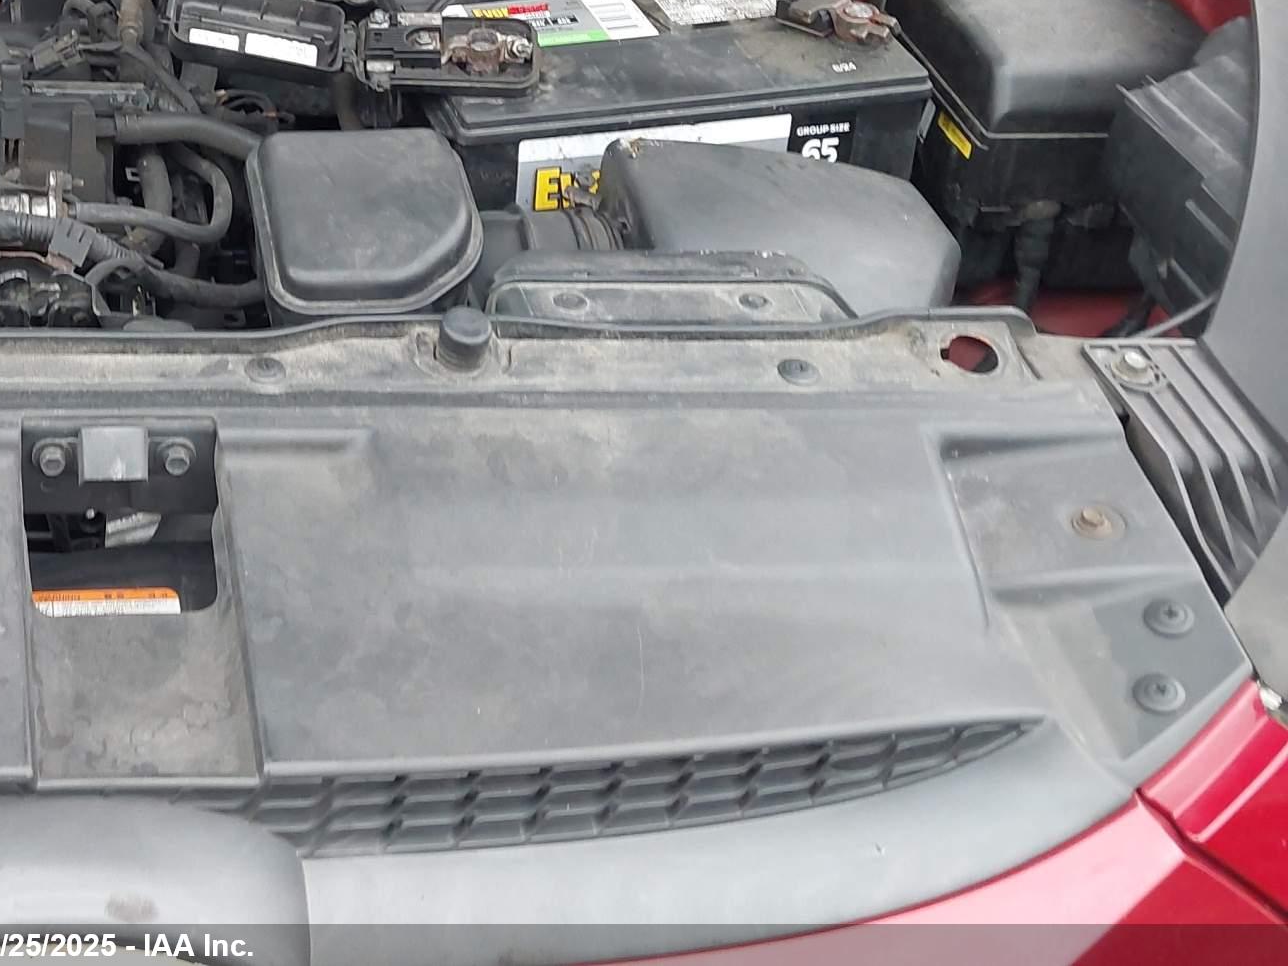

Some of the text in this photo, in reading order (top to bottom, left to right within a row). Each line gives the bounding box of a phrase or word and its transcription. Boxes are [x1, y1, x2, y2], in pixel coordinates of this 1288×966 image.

[796, 121, 851, 137] GROUP SIZE
[801, 136, 840, 163] 65
